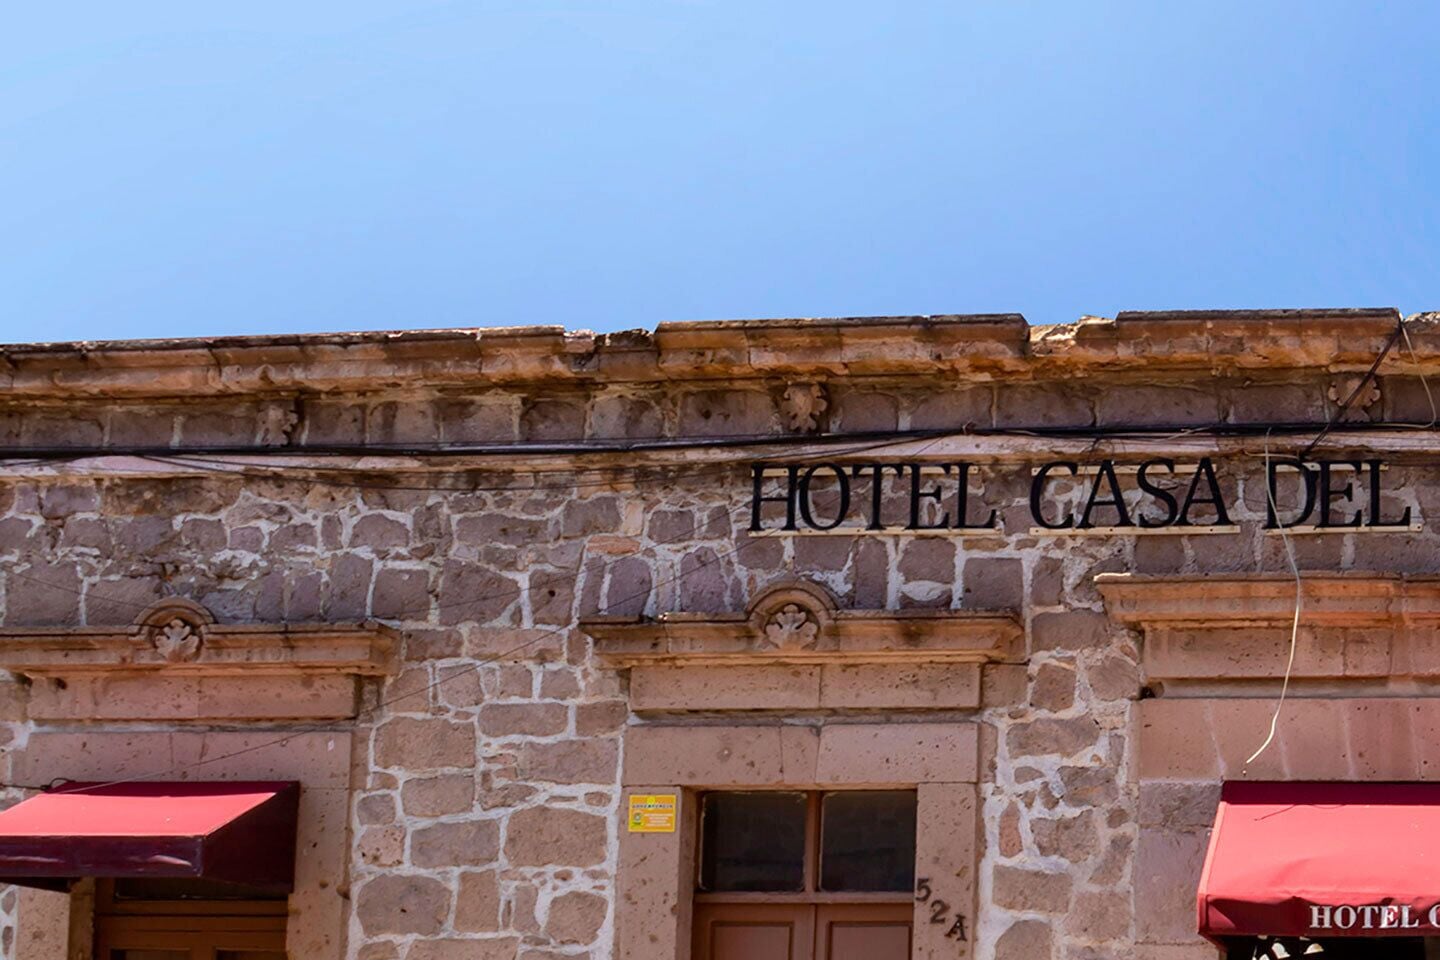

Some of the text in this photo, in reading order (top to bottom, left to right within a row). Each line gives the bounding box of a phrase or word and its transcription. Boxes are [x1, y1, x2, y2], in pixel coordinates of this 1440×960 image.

[749, 462, 997, 532] HOTEL
[1029, 457, 1235, 530] CASA
[1264, 458, 1413, 529] DEL
[1309, 904, 1419, 929] HOTEL
